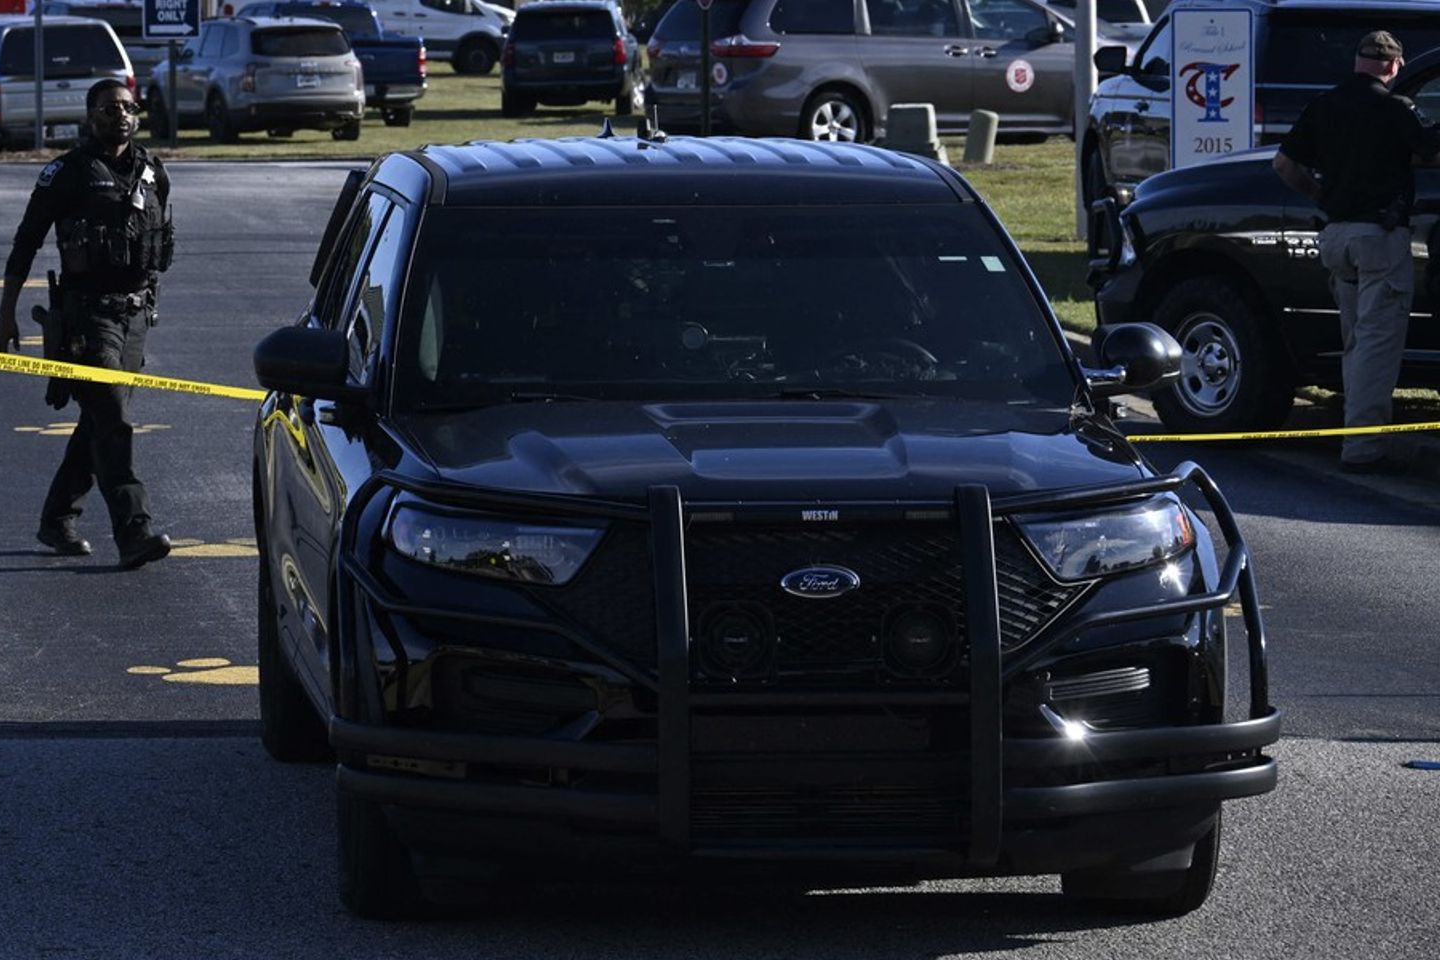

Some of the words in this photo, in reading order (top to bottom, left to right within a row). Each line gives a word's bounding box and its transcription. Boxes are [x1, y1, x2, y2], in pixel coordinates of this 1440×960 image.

[157, 10, 186, 22] ONLY
[1194, 137, 1233, 154] 2015
[1284, 236, 1319, 246] RA
[18, 359, 30, 367] LINE
[32, 361, 40, 369] DO
[42, 362, 53, 370] NOT
[54, 364, 73, 374] CROSS
[134, 376, 153, 385] POLICE
[154, 379, 168, 387] LINE
[192, 384, 210, 392] CROSS
[800, 574, 840, 590] Ford
